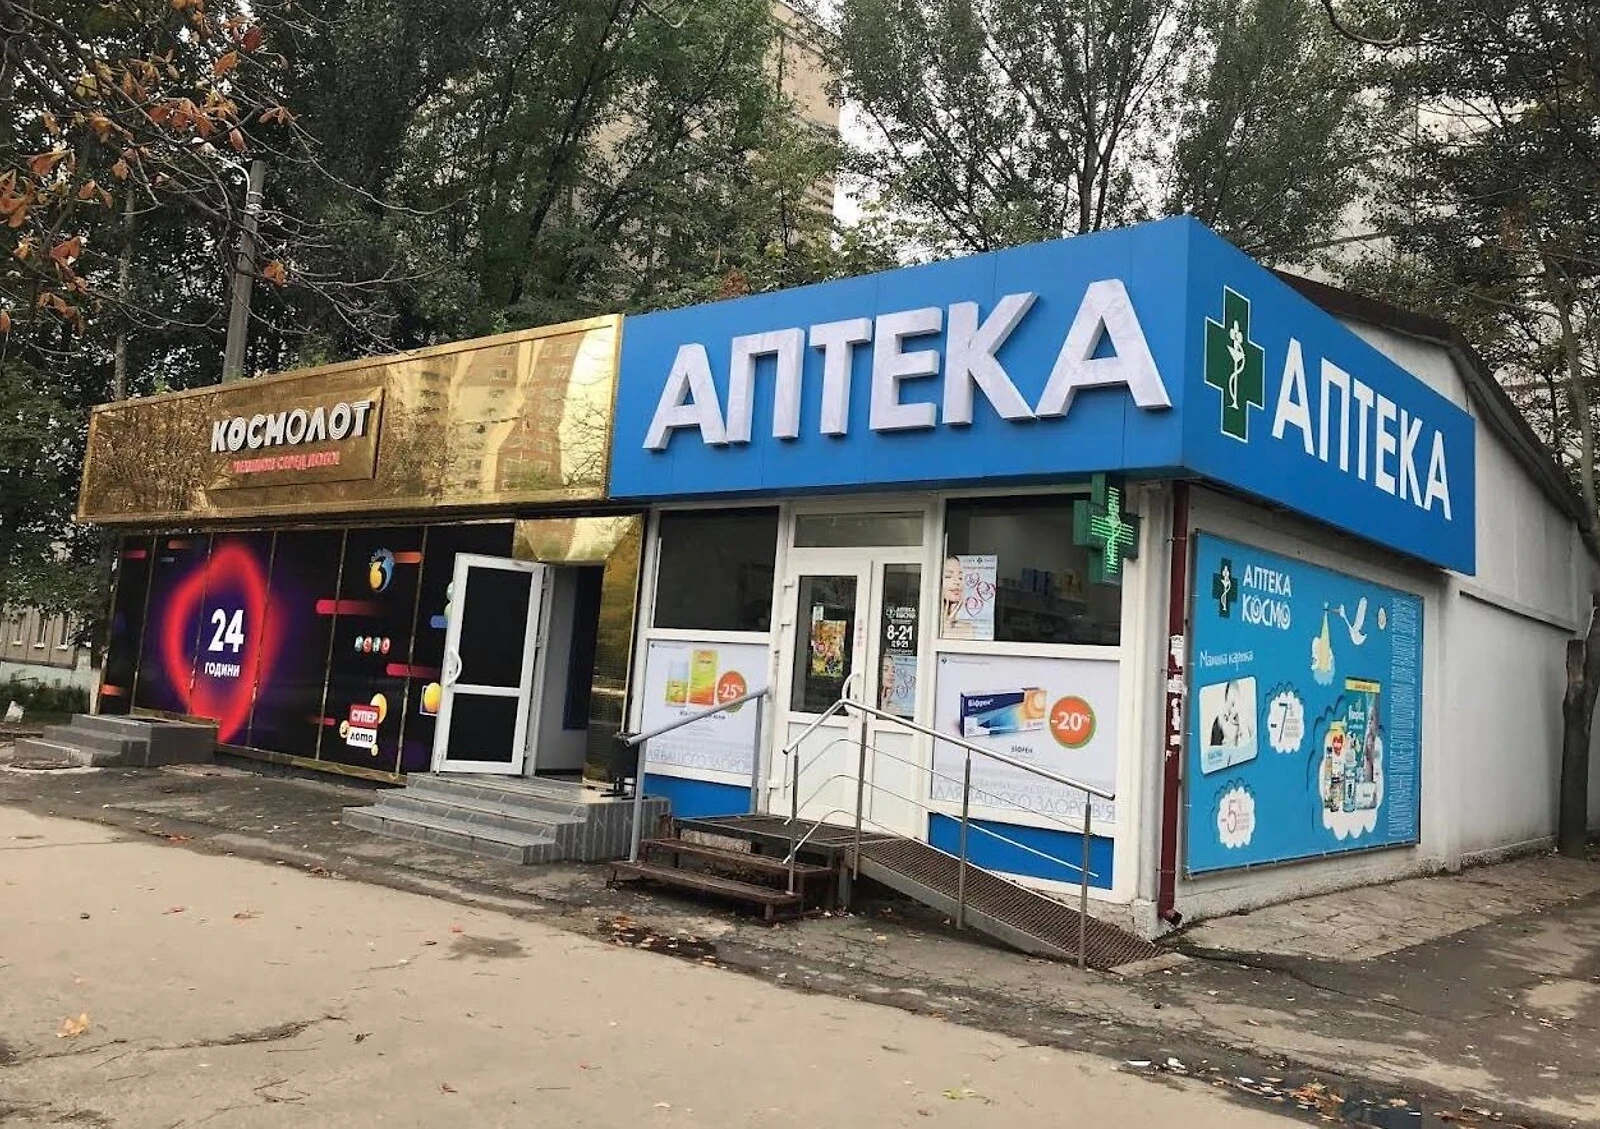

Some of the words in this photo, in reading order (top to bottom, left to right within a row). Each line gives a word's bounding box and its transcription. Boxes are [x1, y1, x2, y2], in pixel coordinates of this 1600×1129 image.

[642, 279, 1172, 450] АПТЕКА
[211, 400, 372, 453] КОСМОЛОТ
[1271, 337, 1452, 521] АПТЕКА
[1243, 564, 1292, 597] АПТЕКА
[208, 608, 245, 653] 24
[887, 624, 913, 640] 8-21
[1242, 594, 1291, 630] КОСМО
[204, 661, 241, 677] ГОДИНИ
